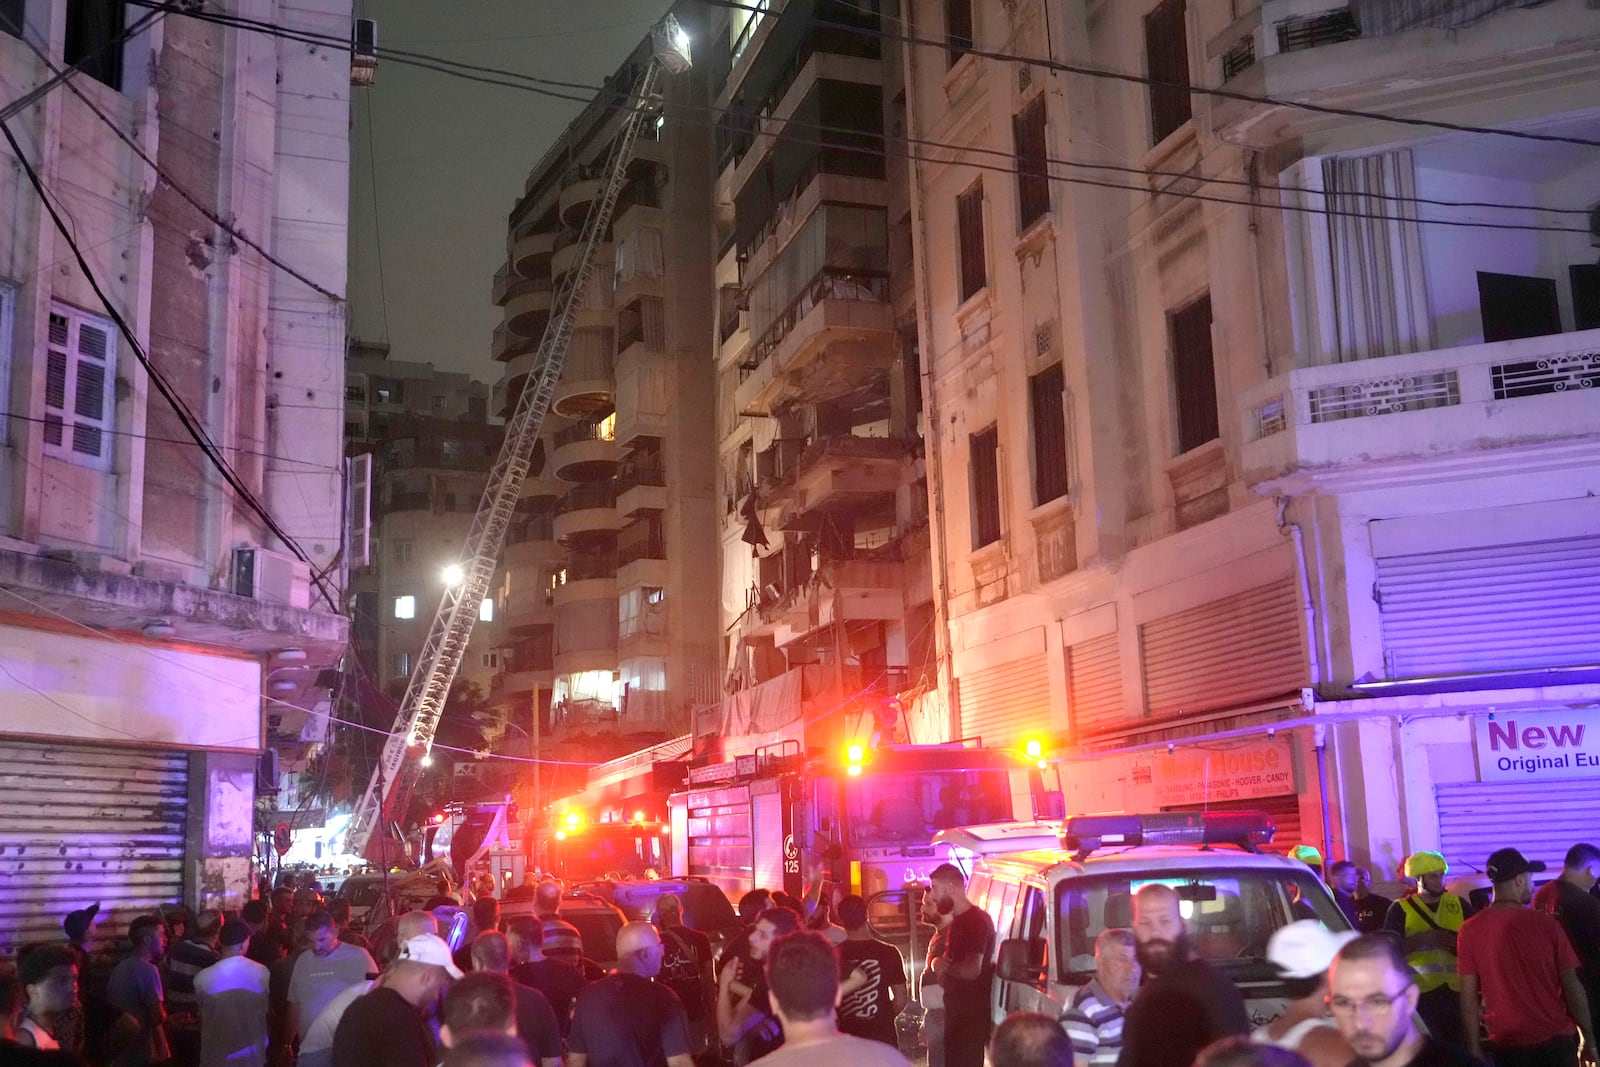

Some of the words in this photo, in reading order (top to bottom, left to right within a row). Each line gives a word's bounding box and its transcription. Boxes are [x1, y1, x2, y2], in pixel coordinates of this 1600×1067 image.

[1488, 720, 1585, 751] New
[1210, 747, 1280, 776] House
[1497, 754, 1569, 773] Original
[1235, 775, 1262, 786] HOOVER
[1266, 772, 1289, 783] CANDY
[1216, 789, 1240, 798] PHILIPS
[785, 860, 799, 873] 125
